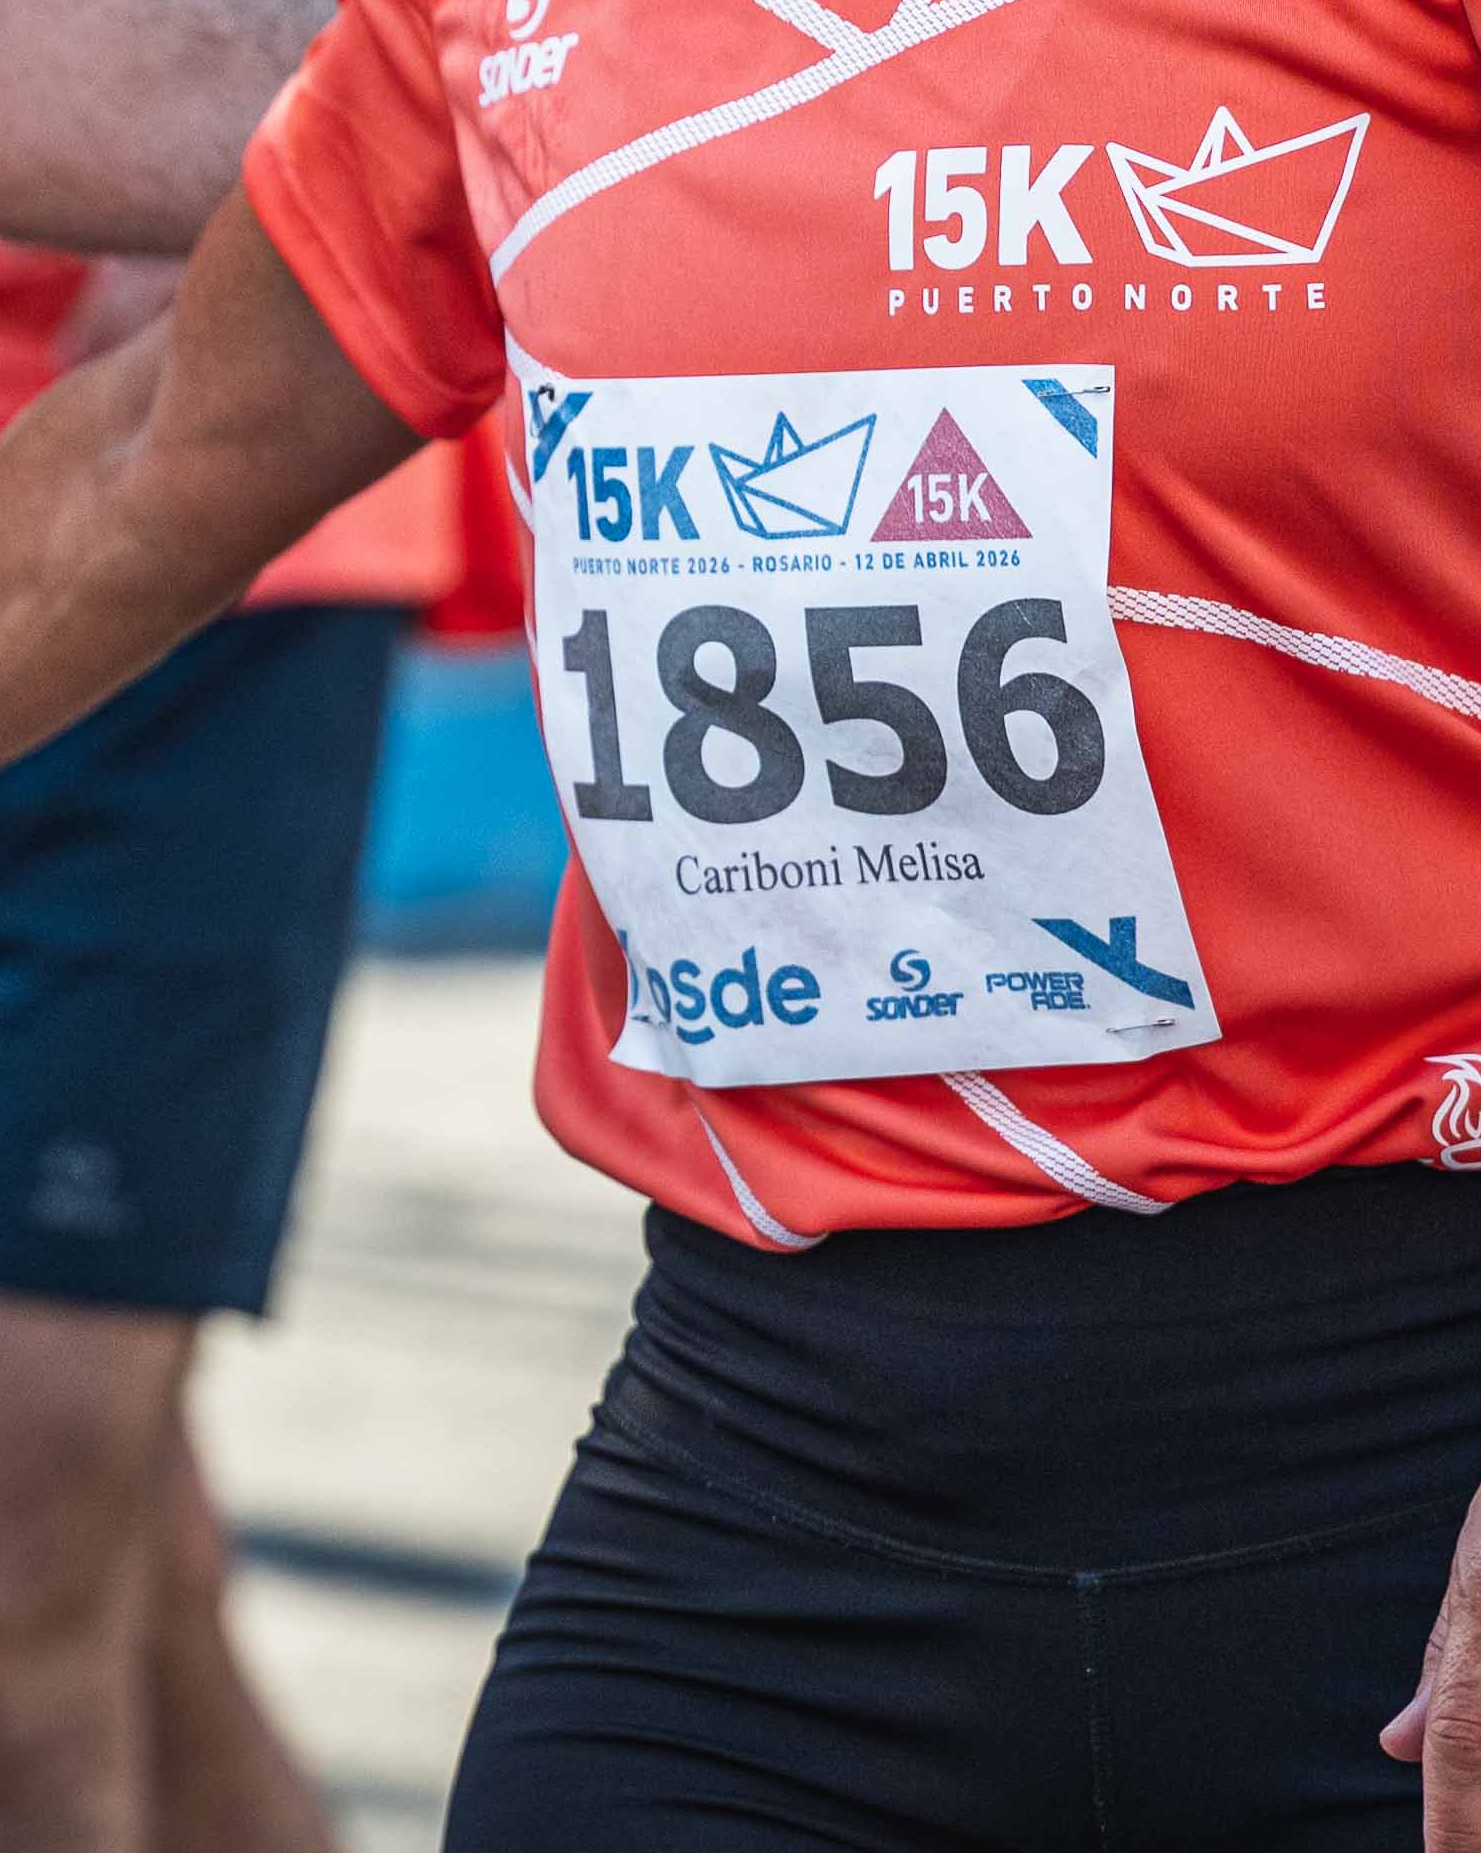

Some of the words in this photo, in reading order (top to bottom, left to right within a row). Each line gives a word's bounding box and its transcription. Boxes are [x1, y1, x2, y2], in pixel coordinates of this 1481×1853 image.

[873, 144, 1094, 271] 15K
[888, 283, 1093, 316] PUERTO
[1124, 283, 1325, 311] NORTE
[567, 446, 700, 542] 15K
[906, 473, 994, 526] 15K
[573, 556, 621, 575] PUERTO
[627, 556, 680, 575] NORTE
[687, 556, 730, 574] 2026
[752, 554, 832, 573] ROSARIO
[855, 553, 874, 571] 12
[882, 552, 905, 570] DE
[913, 551, 969, 570] ABRIL
[976, 549, 1021, 568] 2026
[562, 597, 1105, 825] 1856
[676, 845, 842, 895] Cariboni
[853, 843, 984, 885] Melisa
[985, 971, 1084, 993] POWER
